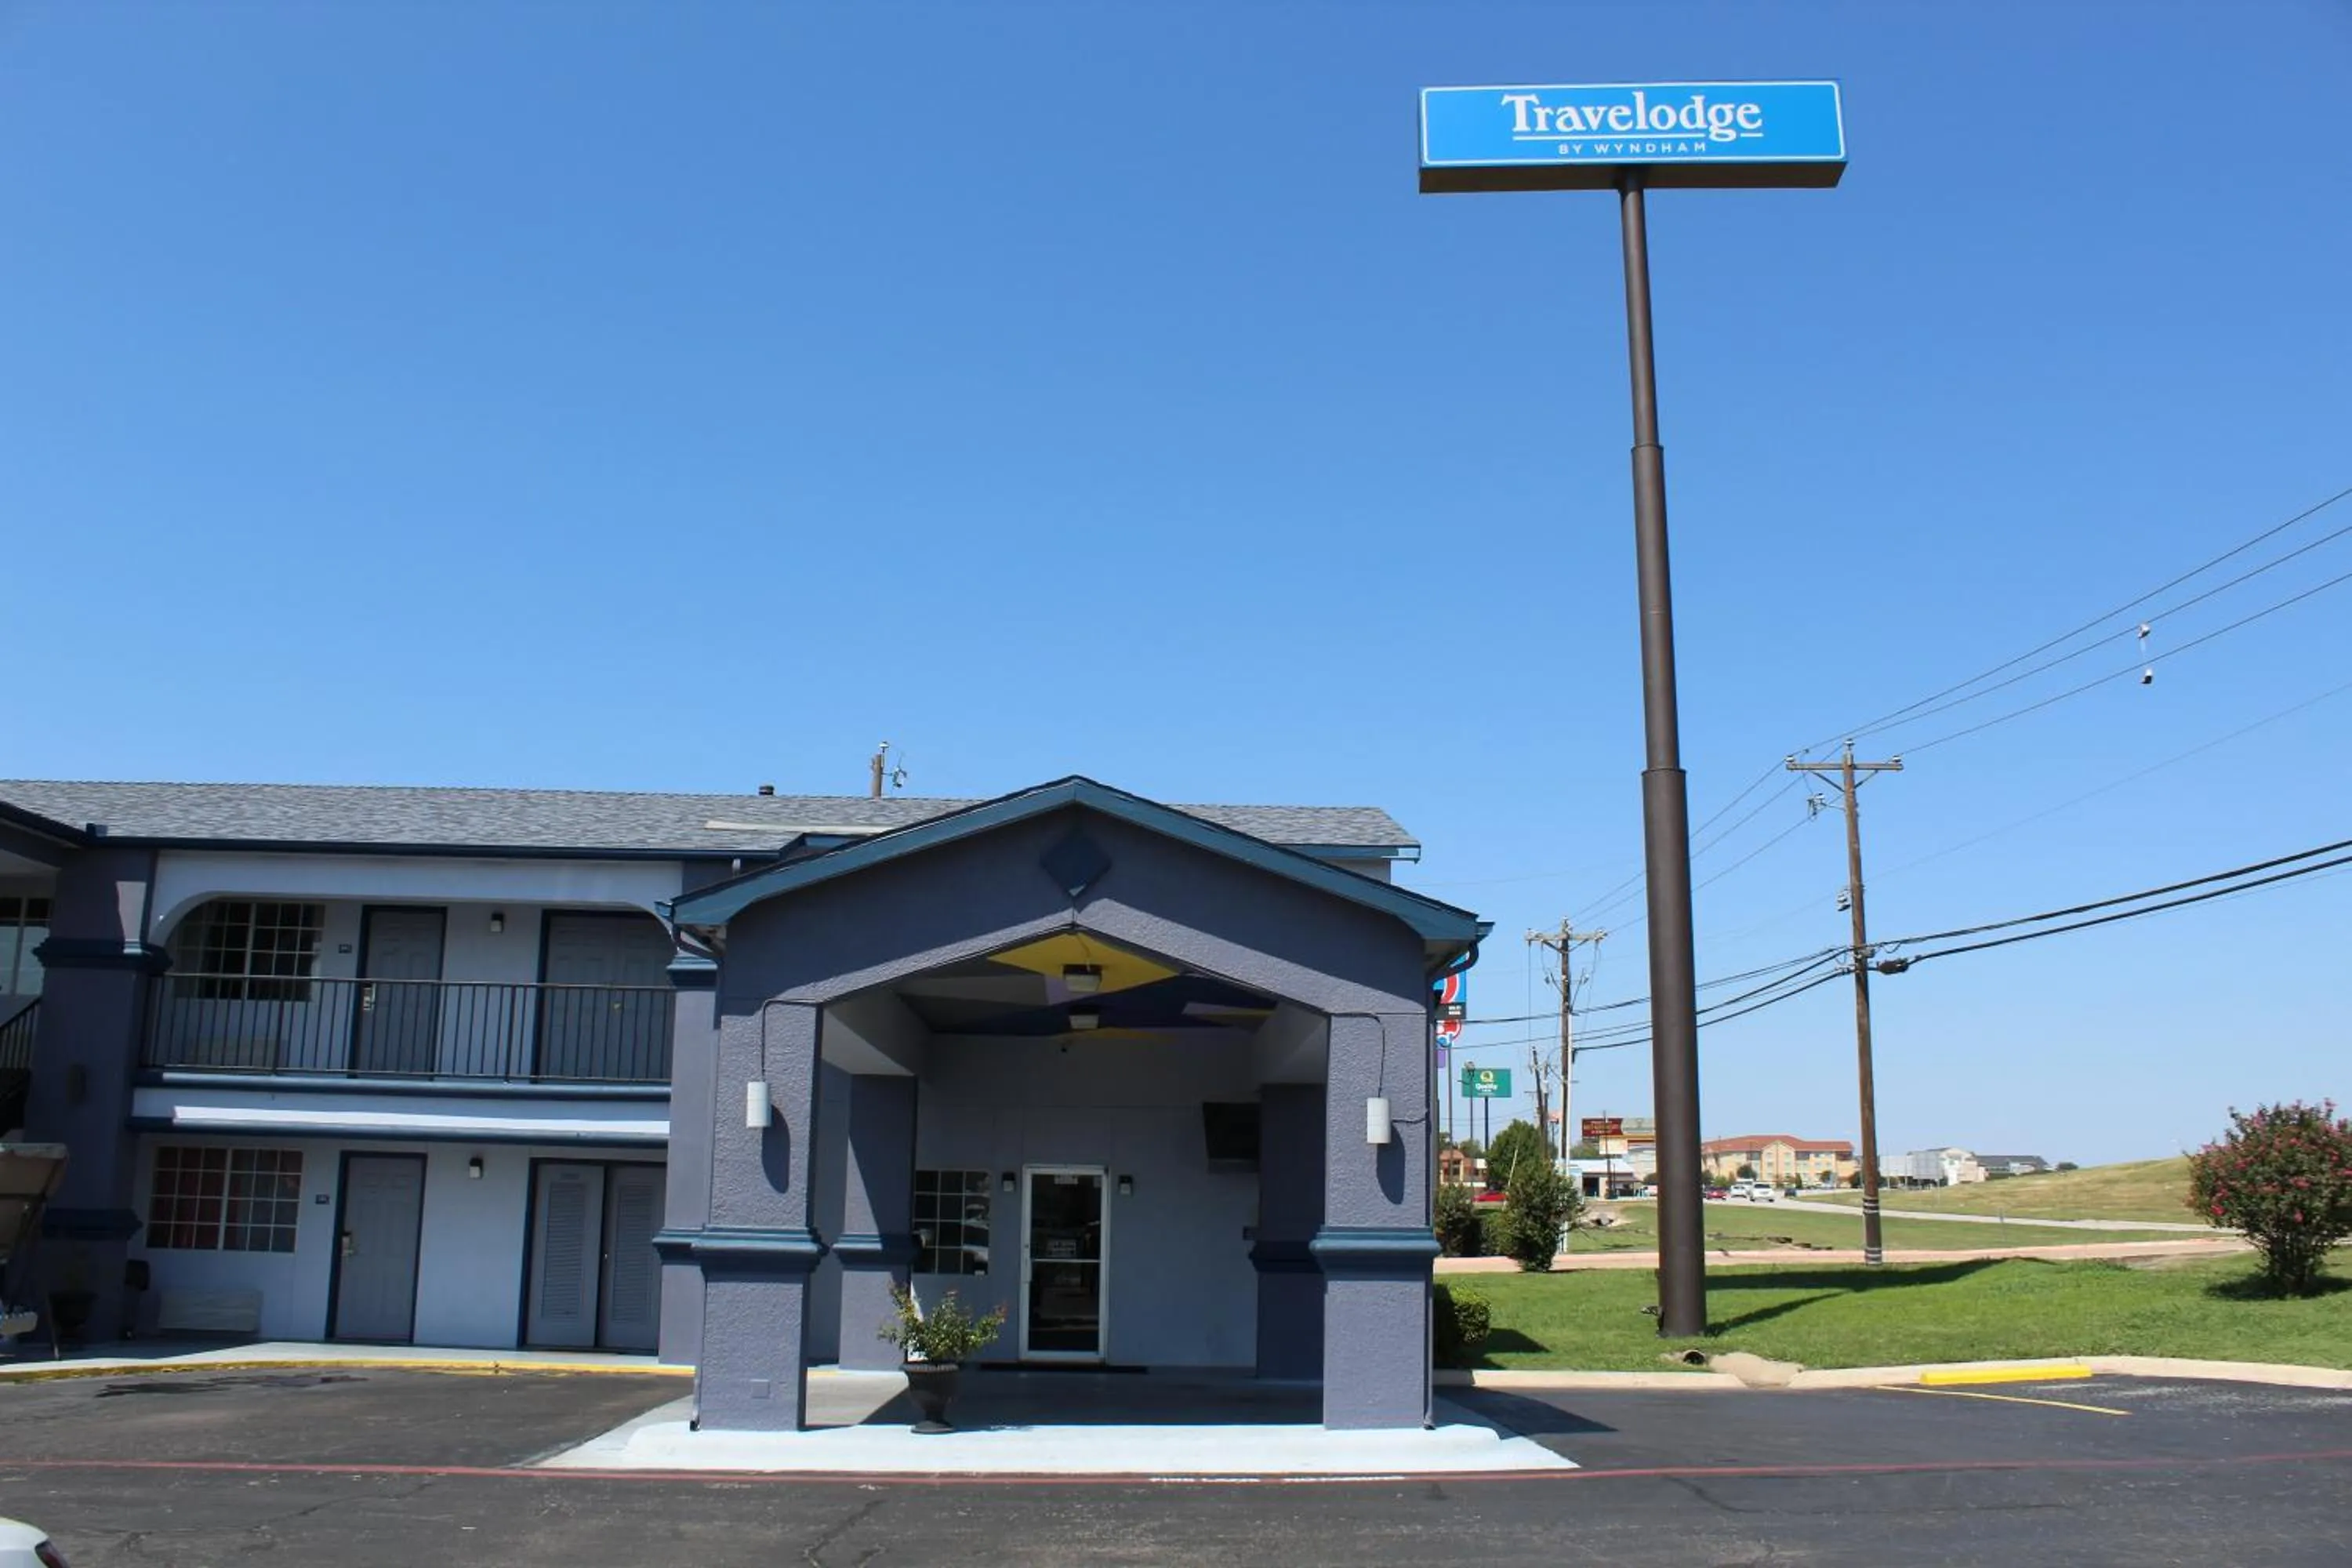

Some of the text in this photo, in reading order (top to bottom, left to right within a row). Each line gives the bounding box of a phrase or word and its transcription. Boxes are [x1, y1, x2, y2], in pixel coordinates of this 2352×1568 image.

[1501, 90, 1762, 142] Travelodge
[1559, 142, 1707, 154] BY WYNDHAM
